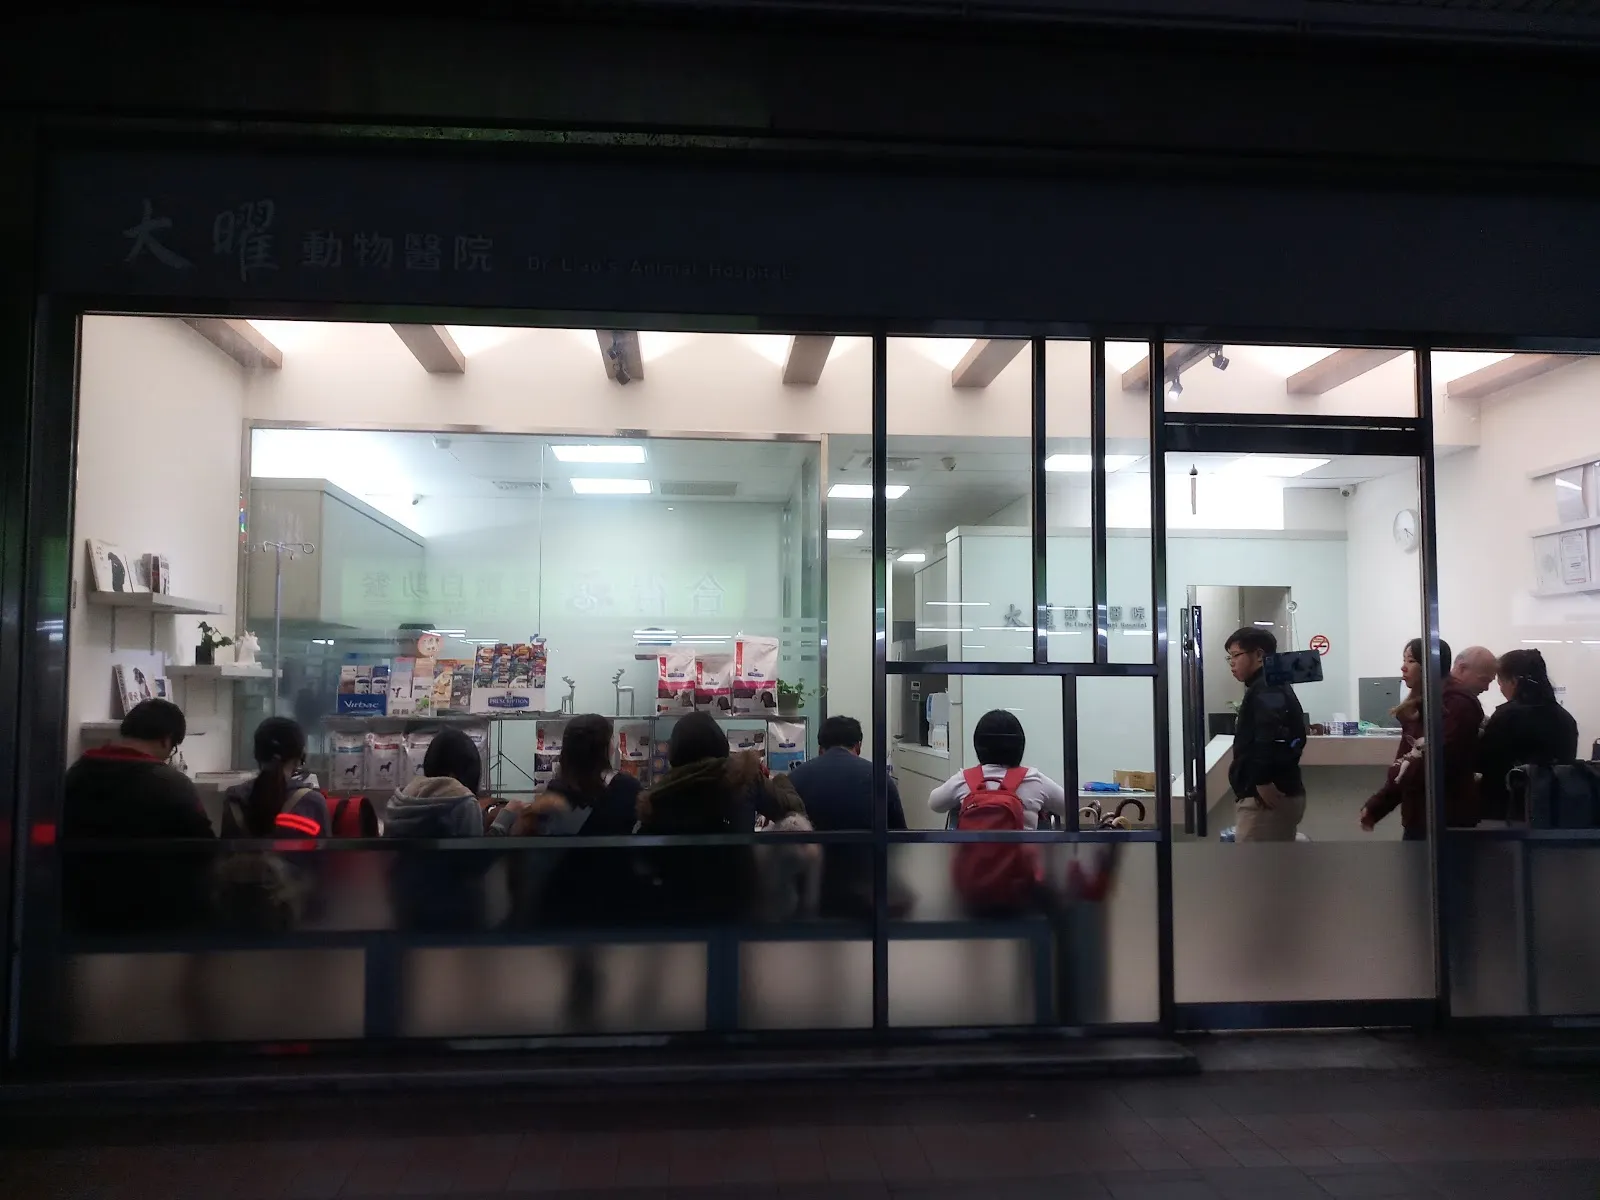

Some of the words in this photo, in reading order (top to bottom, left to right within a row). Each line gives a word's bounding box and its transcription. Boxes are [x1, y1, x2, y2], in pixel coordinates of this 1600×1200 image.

[301, 231, 494, 273] 動物醫院
[630, 258, 697, 278] Animal
[709, 261, 793, 282] Hospital
[343, 699, 380, 709] Virbac
